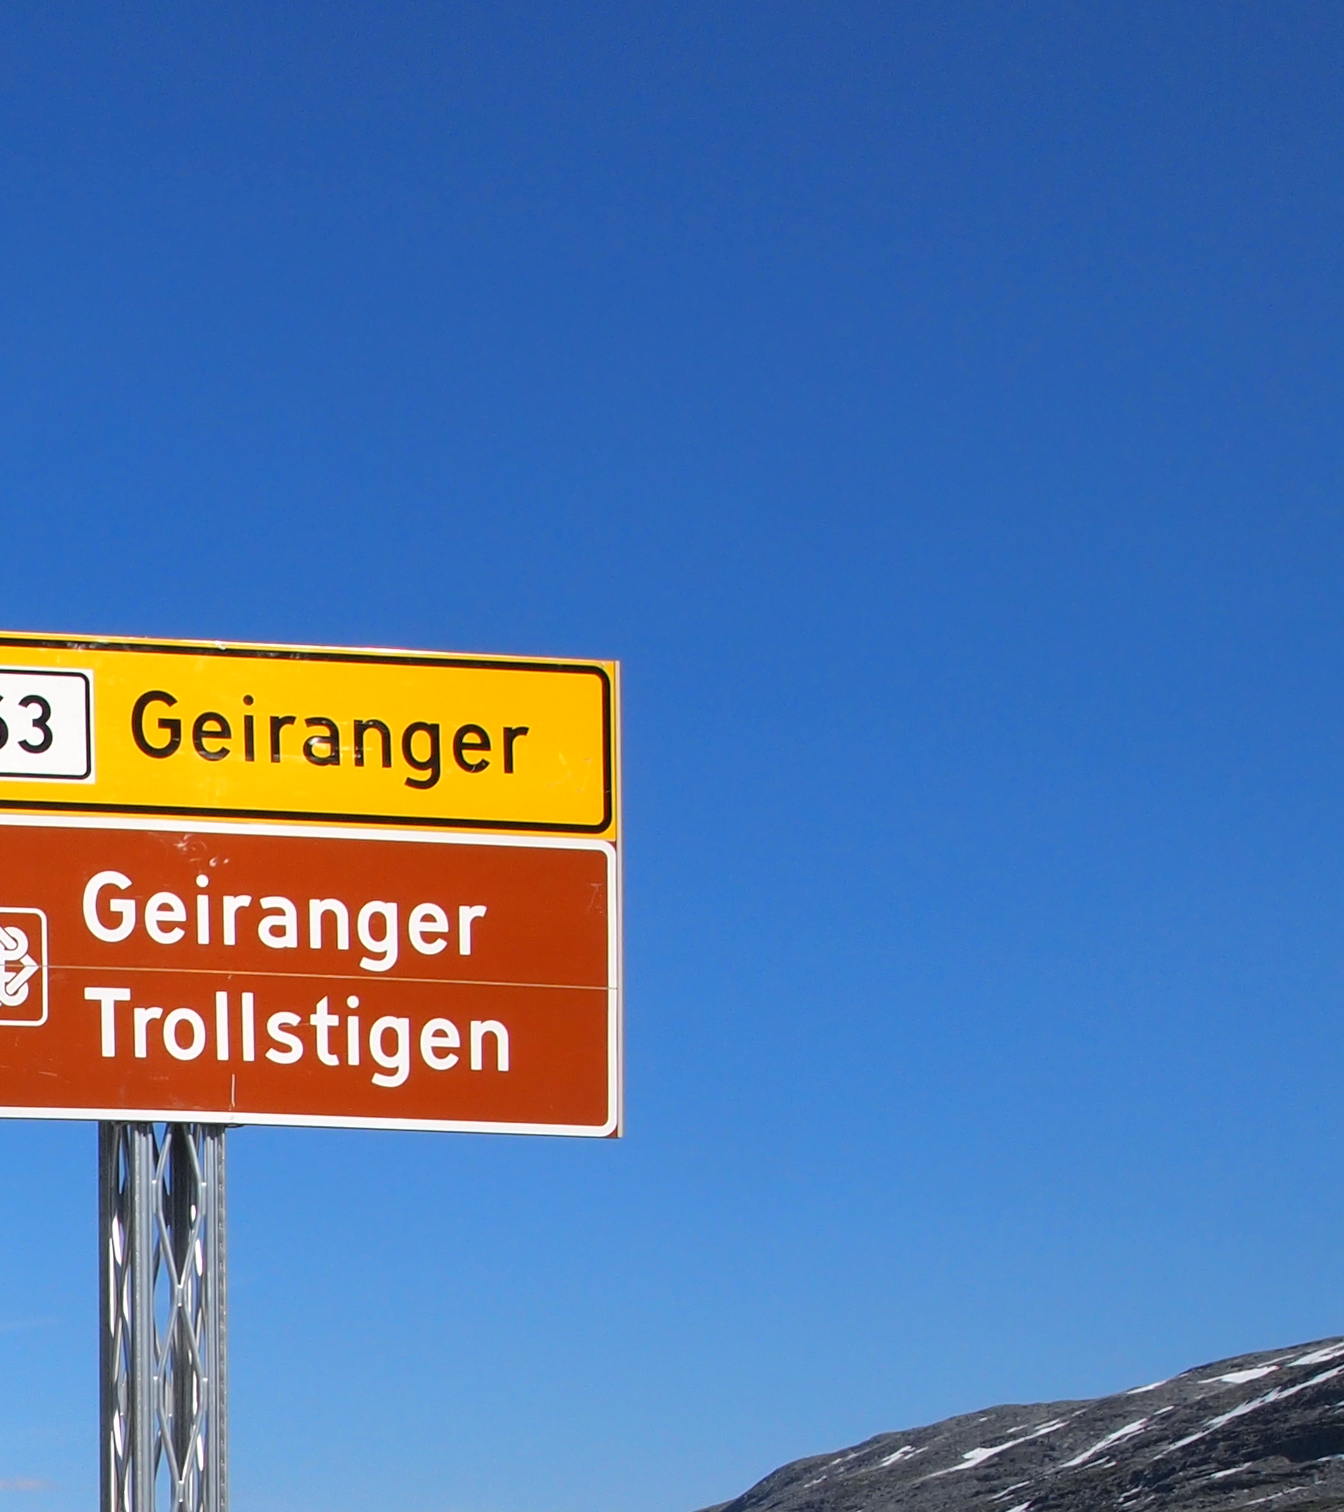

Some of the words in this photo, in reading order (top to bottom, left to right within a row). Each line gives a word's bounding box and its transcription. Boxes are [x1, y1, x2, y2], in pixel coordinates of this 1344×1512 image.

[131, 690, 530, 790] Geiranger
[82, 870, 488, 972] Geiranger
[84, 986, 510, 1088] Trollstigen
